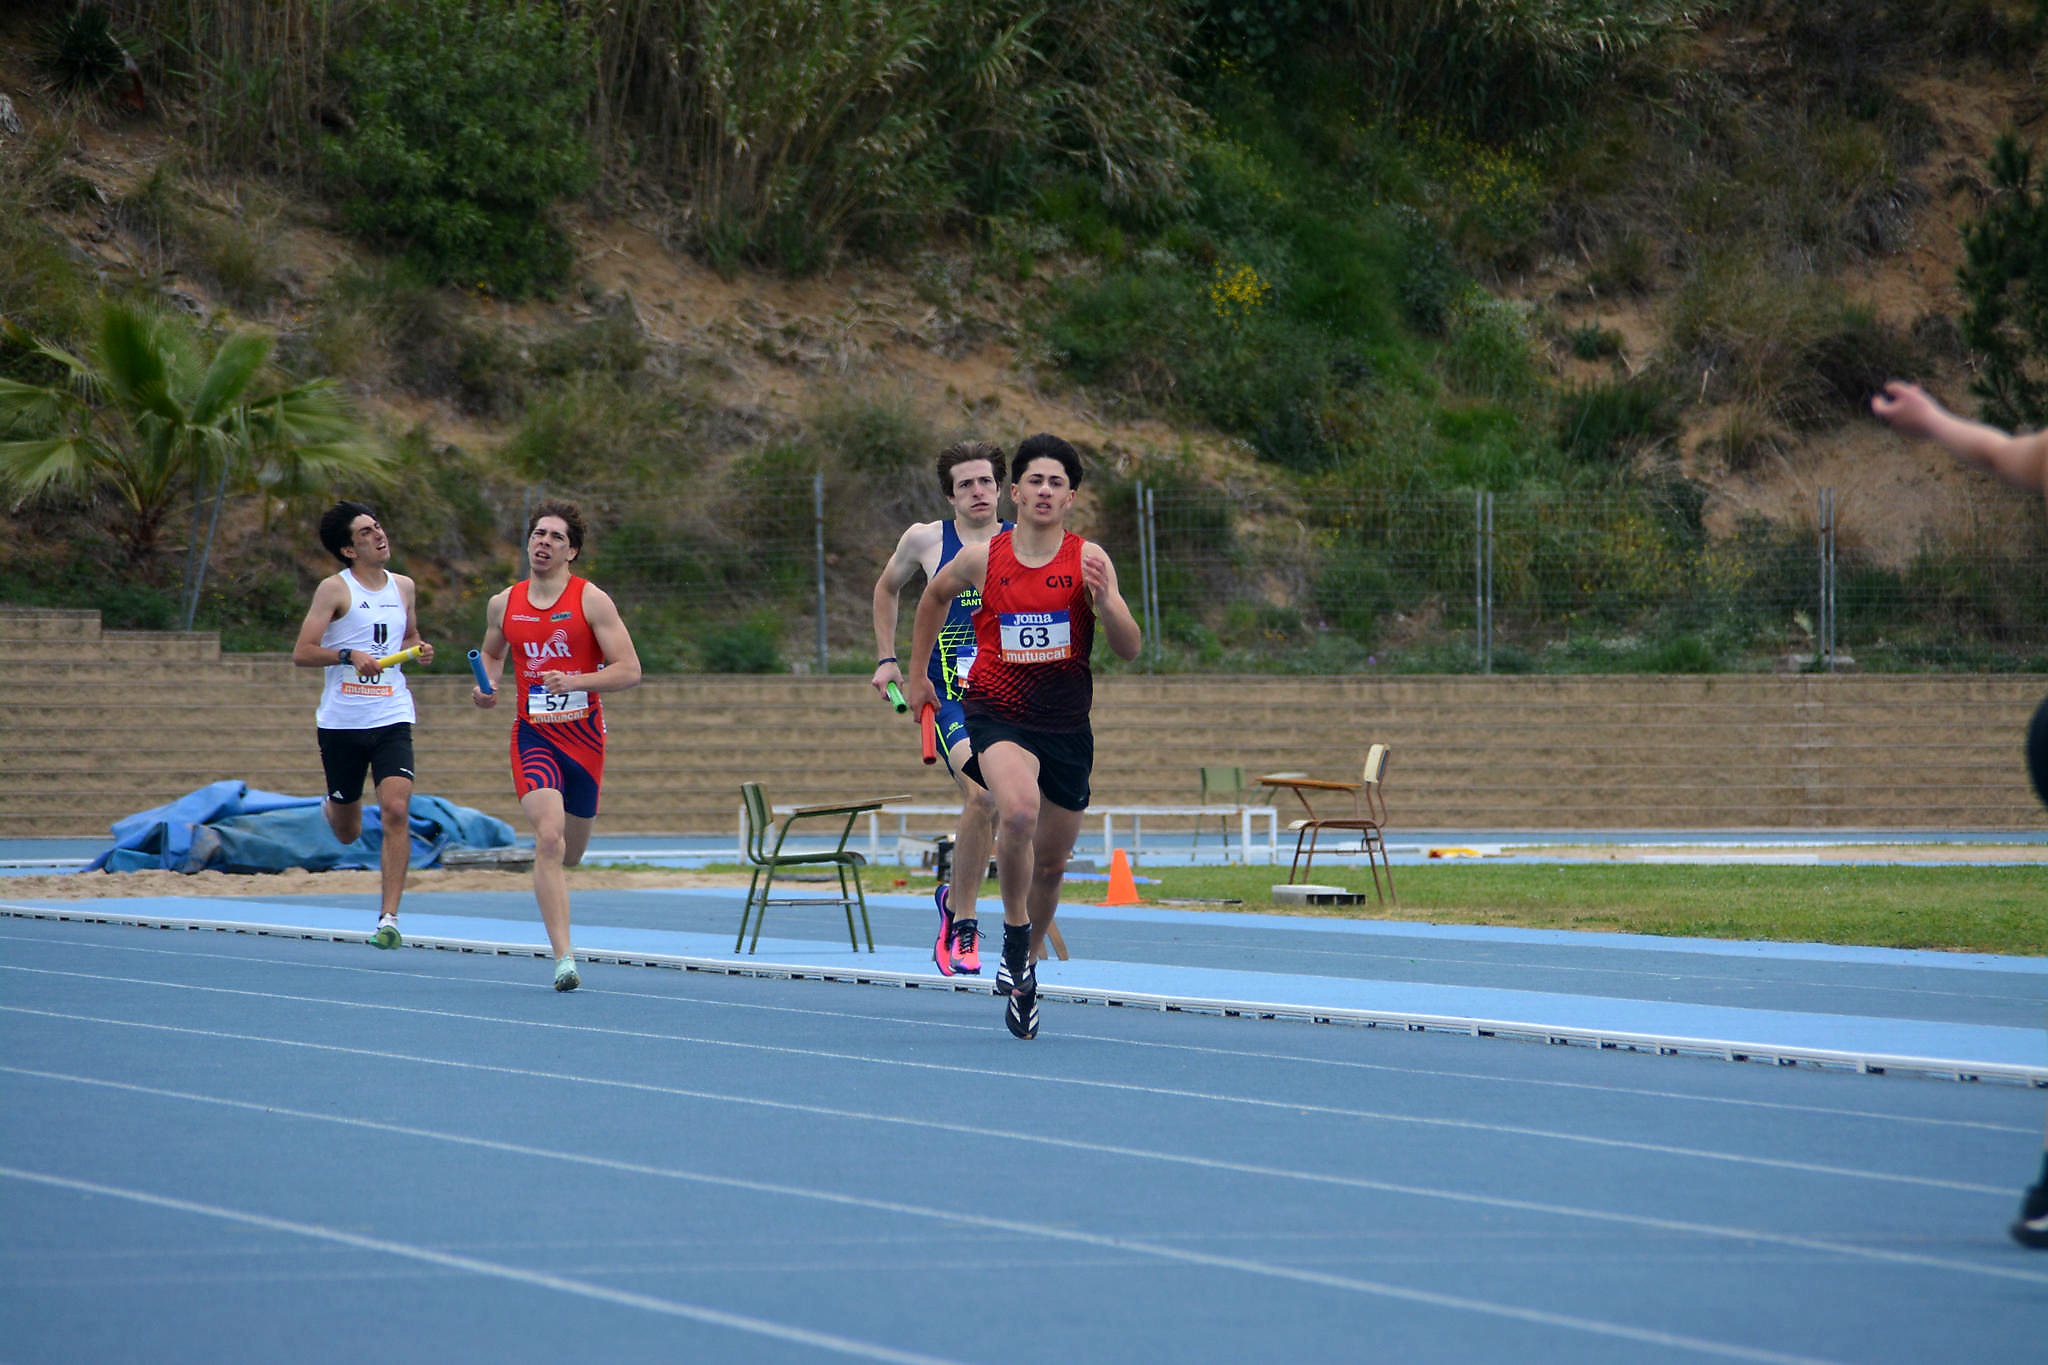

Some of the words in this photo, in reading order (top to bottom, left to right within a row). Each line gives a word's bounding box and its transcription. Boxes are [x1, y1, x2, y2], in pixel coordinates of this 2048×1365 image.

[1019, 626, 1050, 648] 63
[523, 641, 572, 658] UAR
[1007, 647, 1065, 663] mutuacat
[545, 693, 569, 712] 57
